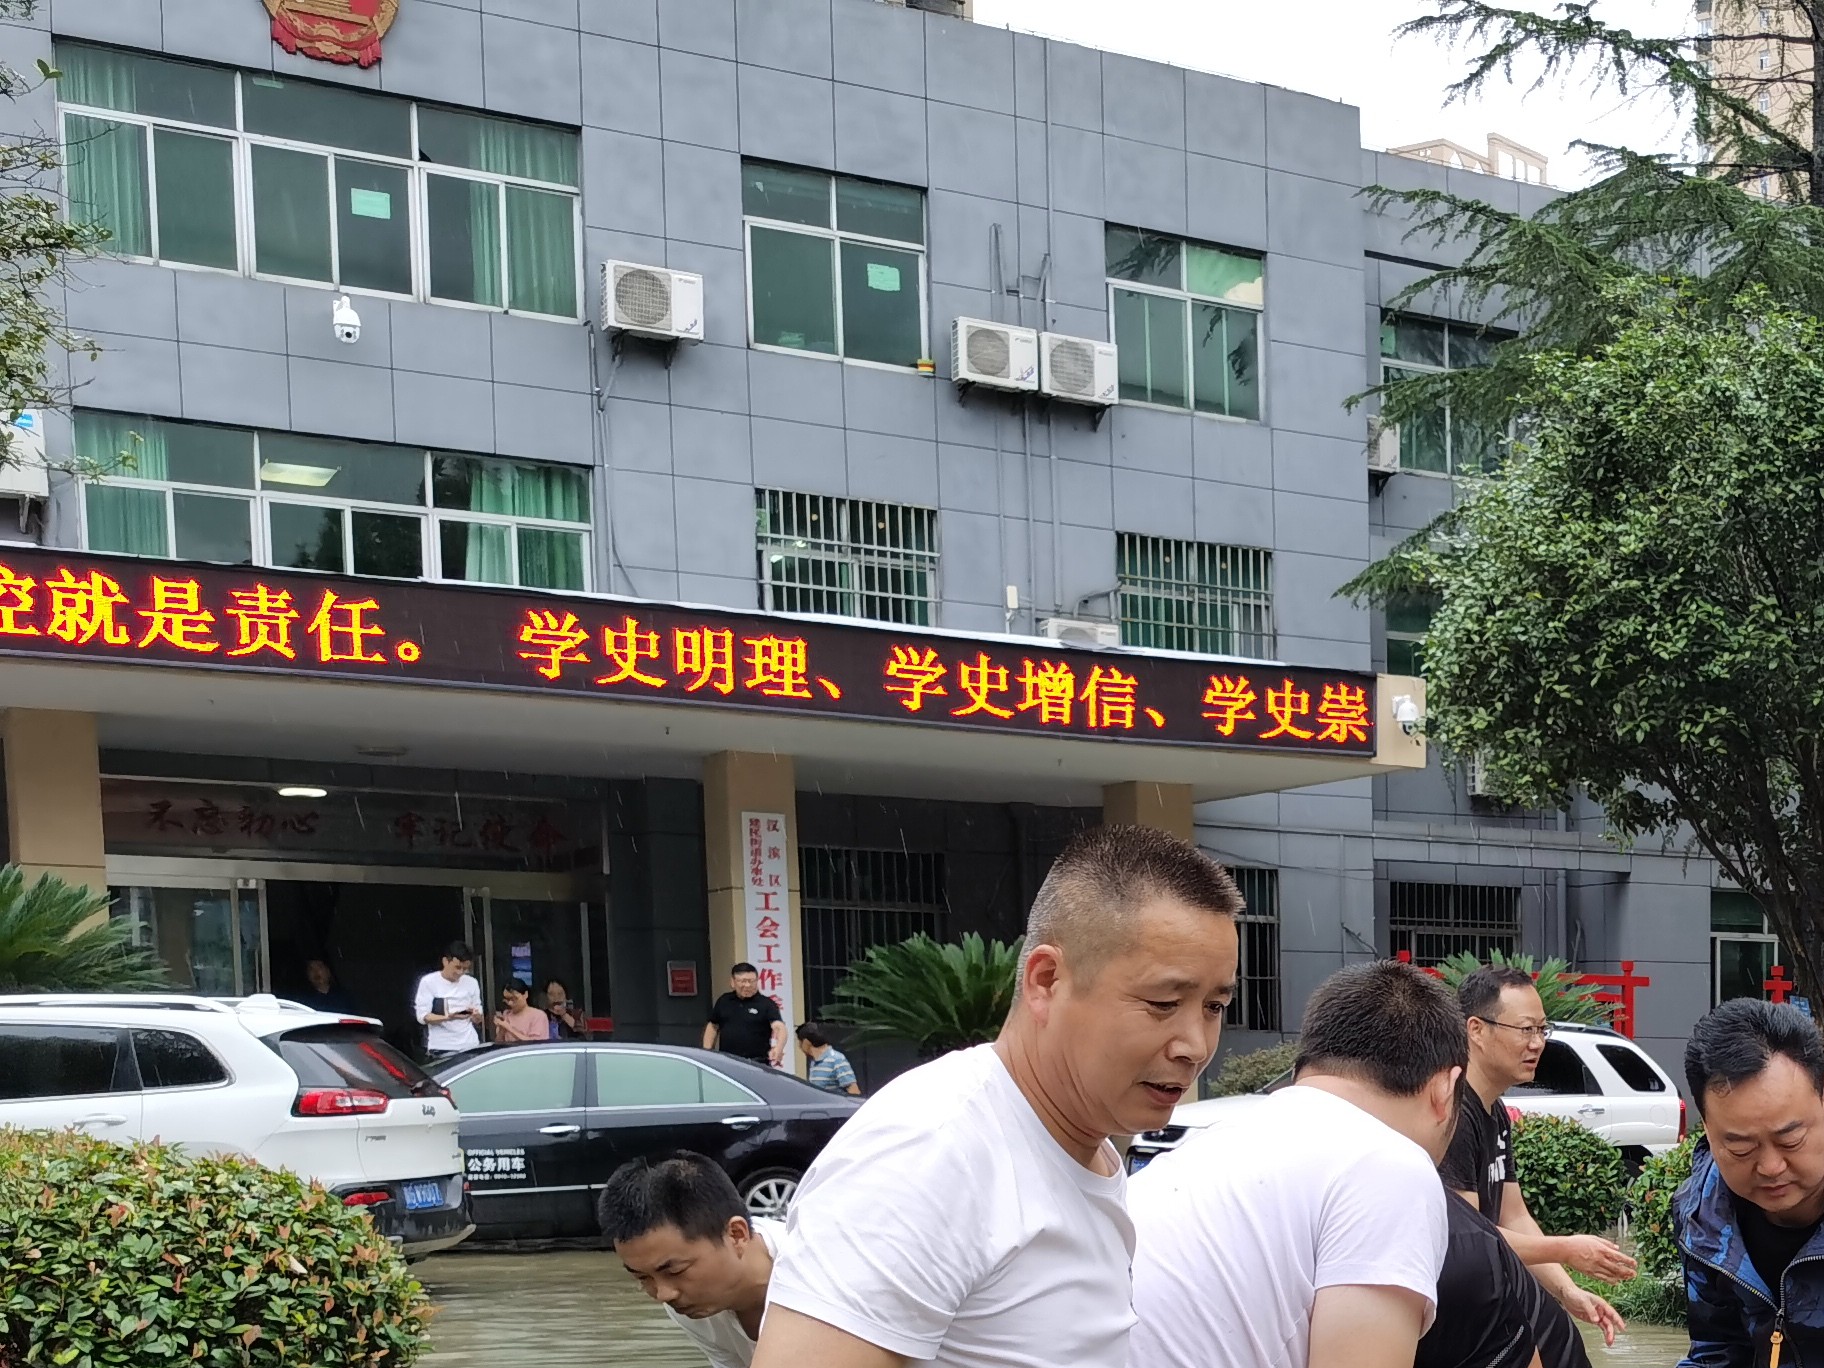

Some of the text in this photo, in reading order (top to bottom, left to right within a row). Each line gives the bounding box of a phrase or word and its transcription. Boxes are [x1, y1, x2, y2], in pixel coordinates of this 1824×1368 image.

[767, 819, 781, 887] 汉滨区
[755, 892, 784, 1068] 工会工作
[467, 1157, 526, 1172] 公务用车
